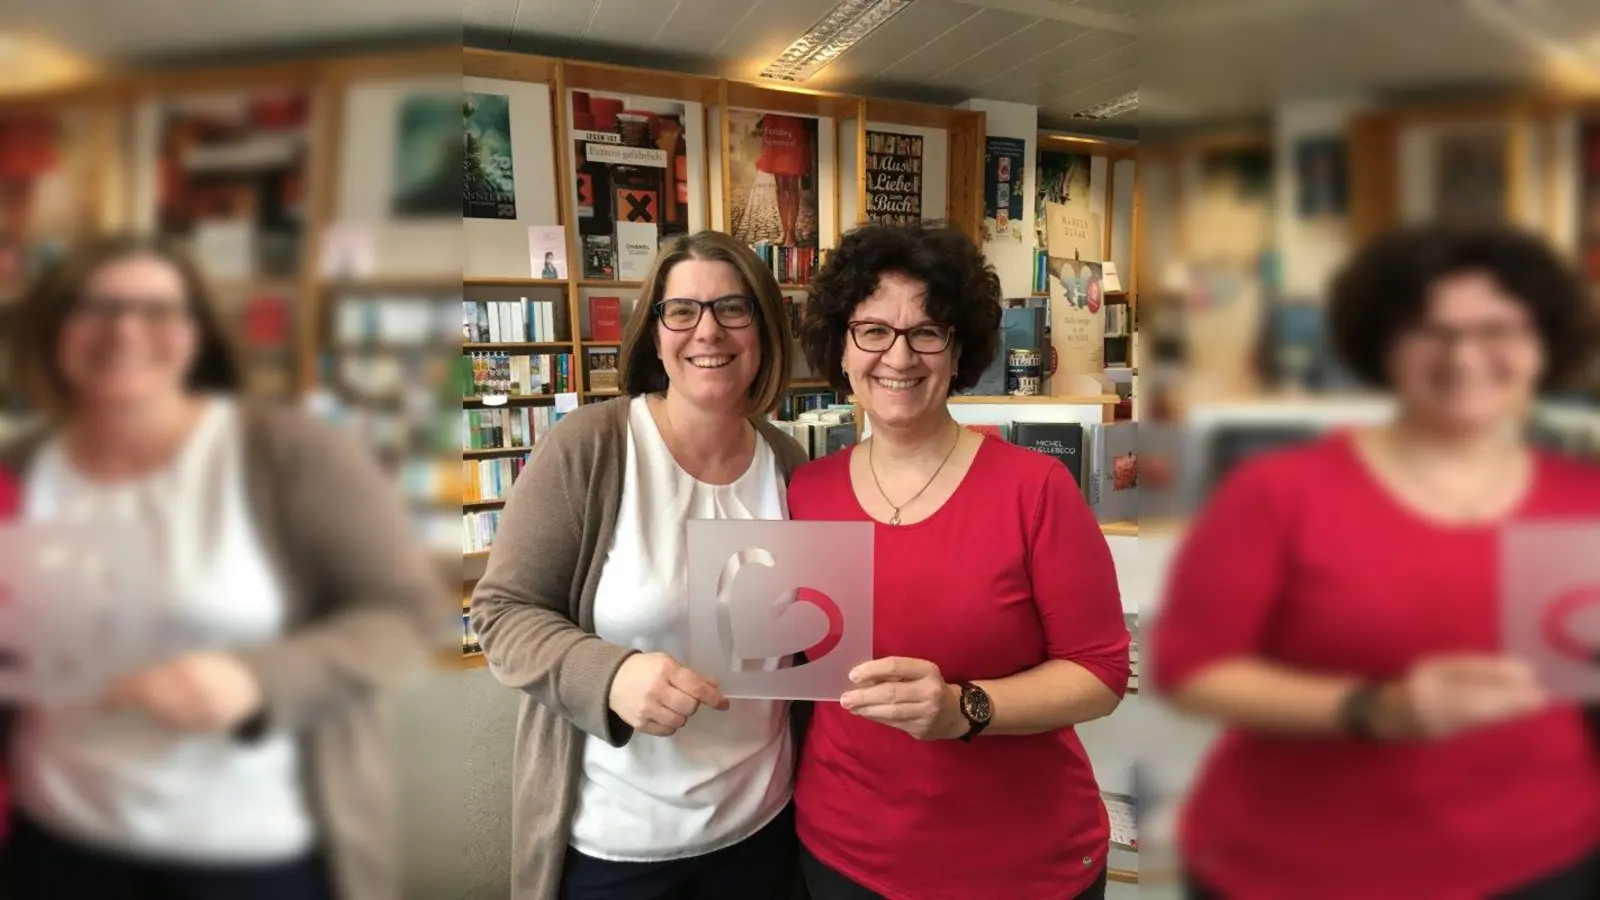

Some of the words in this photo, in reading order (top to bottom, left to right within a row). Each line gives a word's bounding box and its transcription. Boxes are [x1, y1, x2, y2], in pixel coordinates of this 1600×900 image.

[586, 132, 605, 140] LESEN
[606, 134, 618, 142] IST
[589, 145, 620, 157] Extrem
[881, 156, 906, 171] Aus
[873, 173, 911, 192] Liebe
[873, 193, 911, 212] Buch
